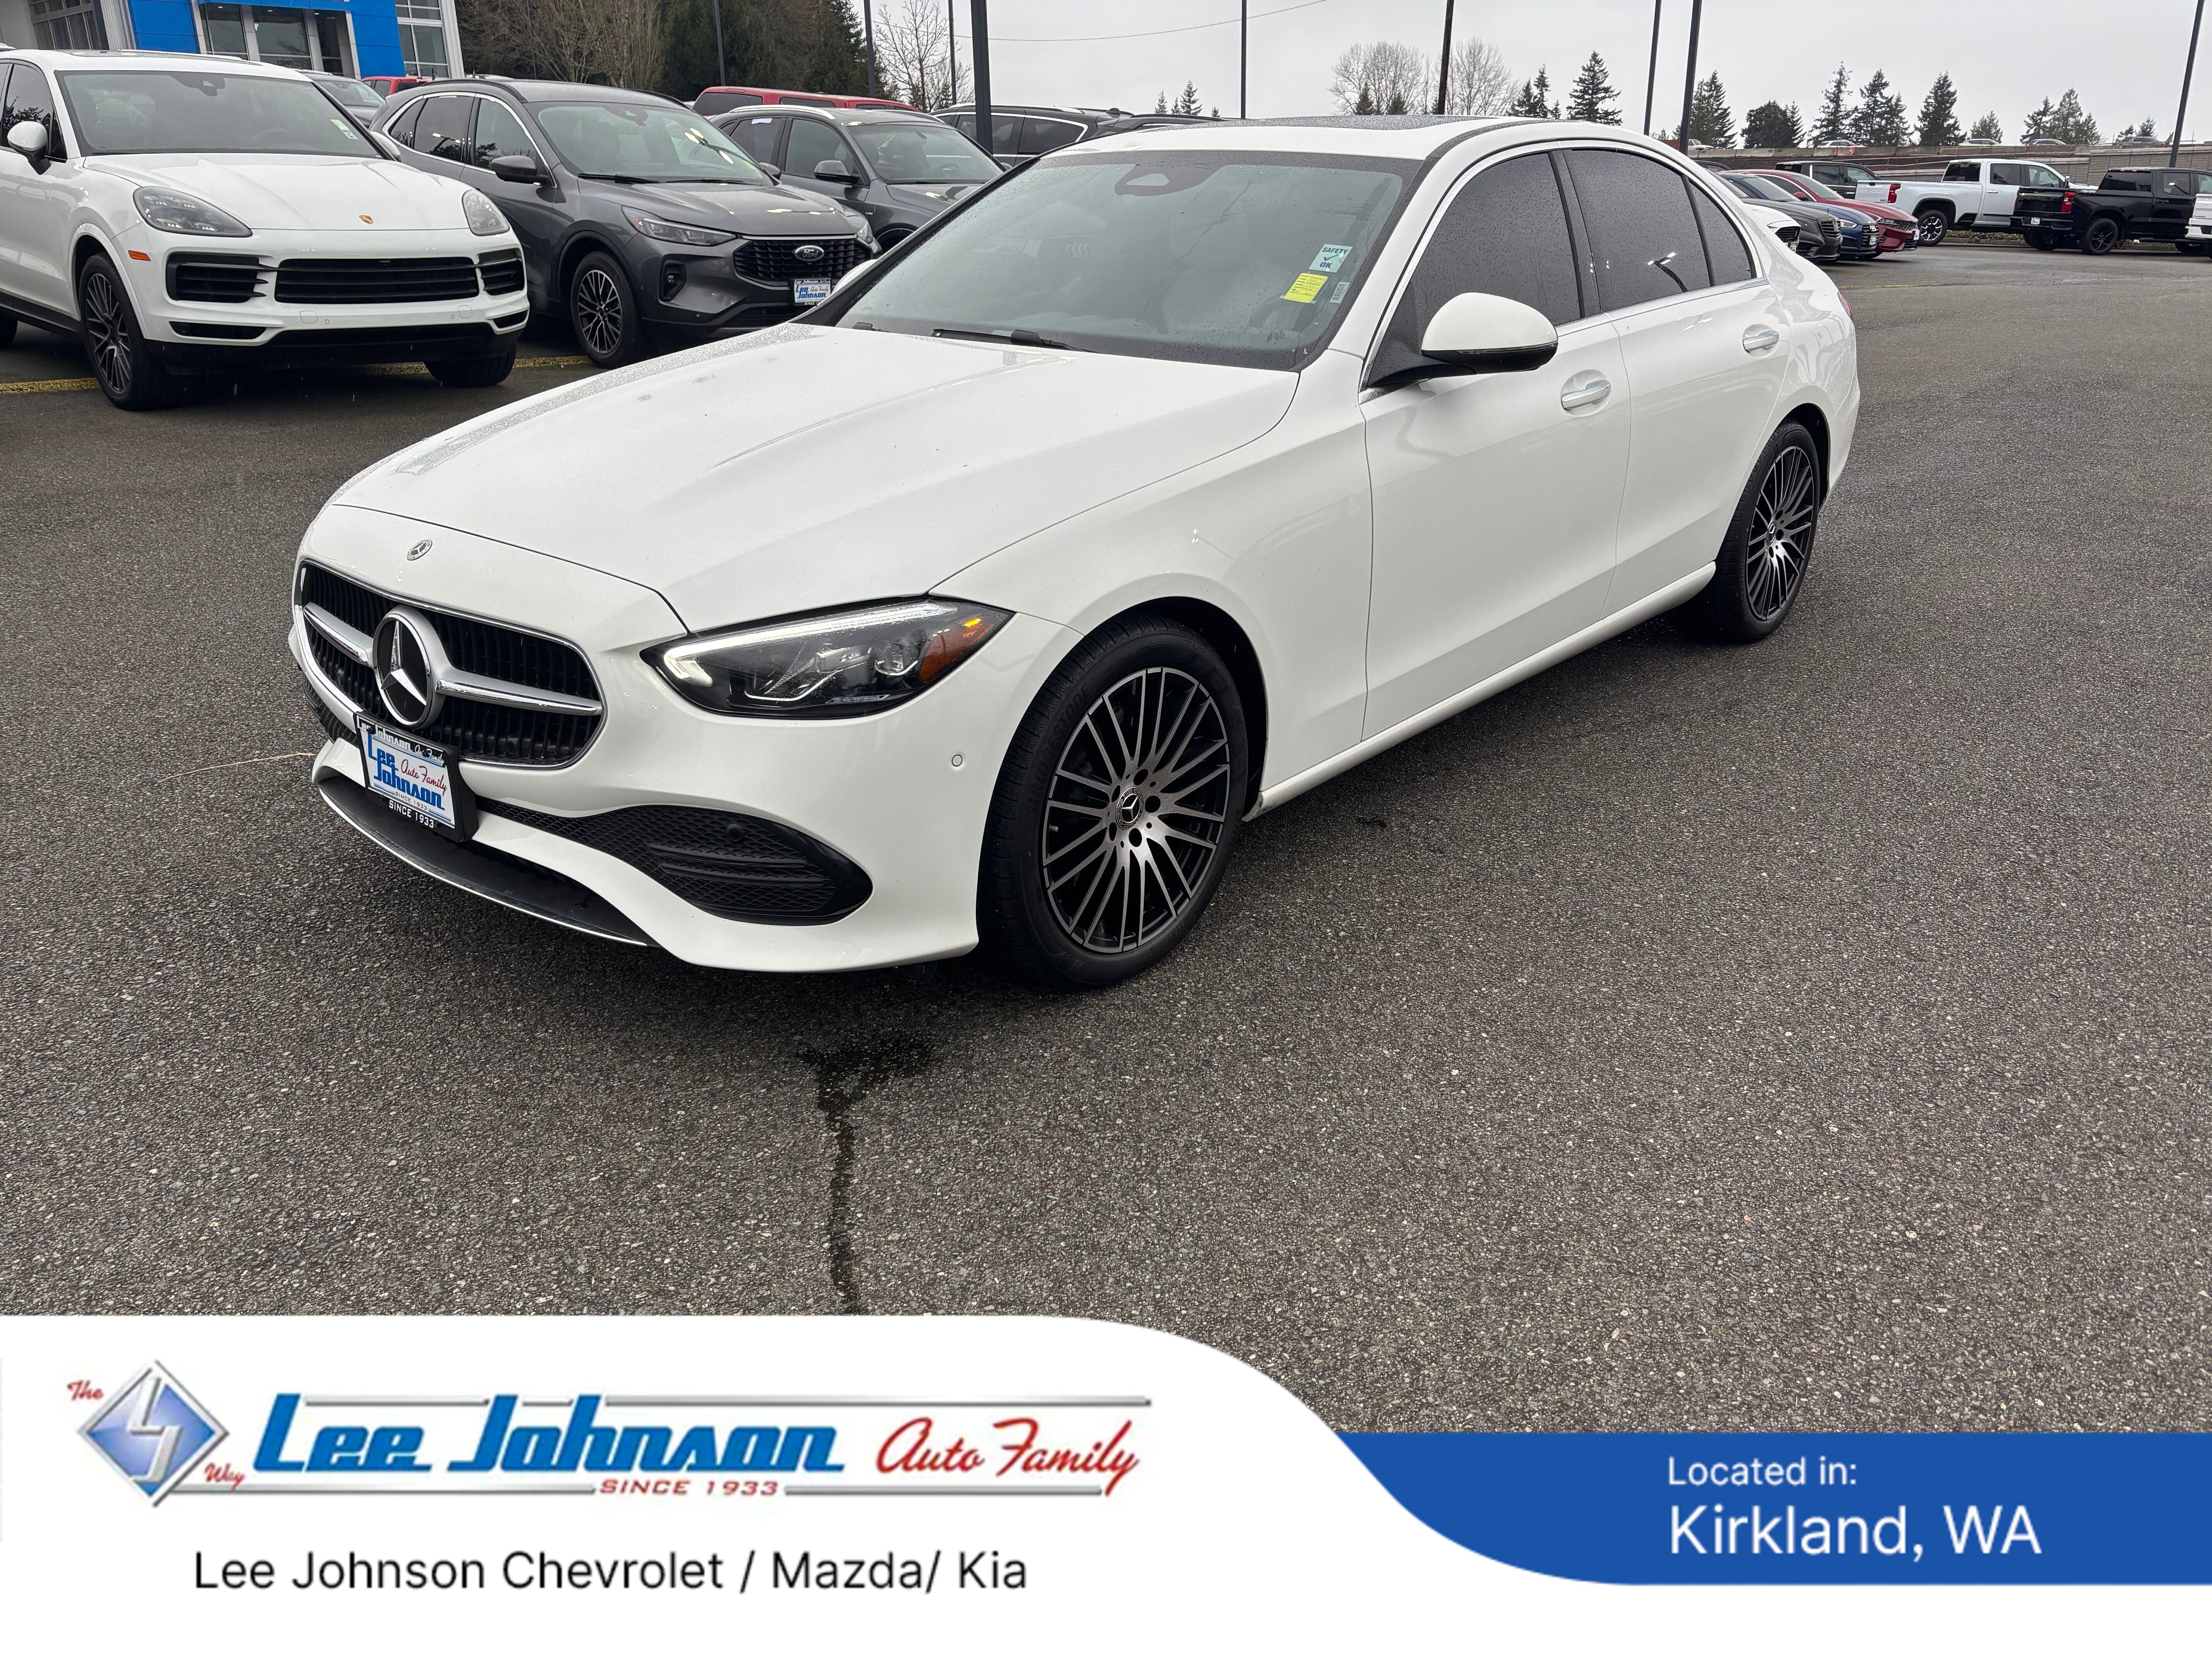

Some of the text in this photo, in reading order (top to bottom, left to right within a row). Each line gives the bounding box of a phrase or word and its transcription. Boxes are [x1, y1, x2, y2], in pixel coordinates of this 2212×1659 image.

[802, 249, 819, 258] Ford
[796, 284, 809, 292] Lee
[374, 724, 413, 752] Johnson
[426, 748, 445, 765] Family
[368, 734, 447, 797] Lee Auto Family
[374, 760, 445, 811] Johnson
[389, 800, 434, 829] SINCE 1933
[395, 791, 428, 811] SINCE 1933
